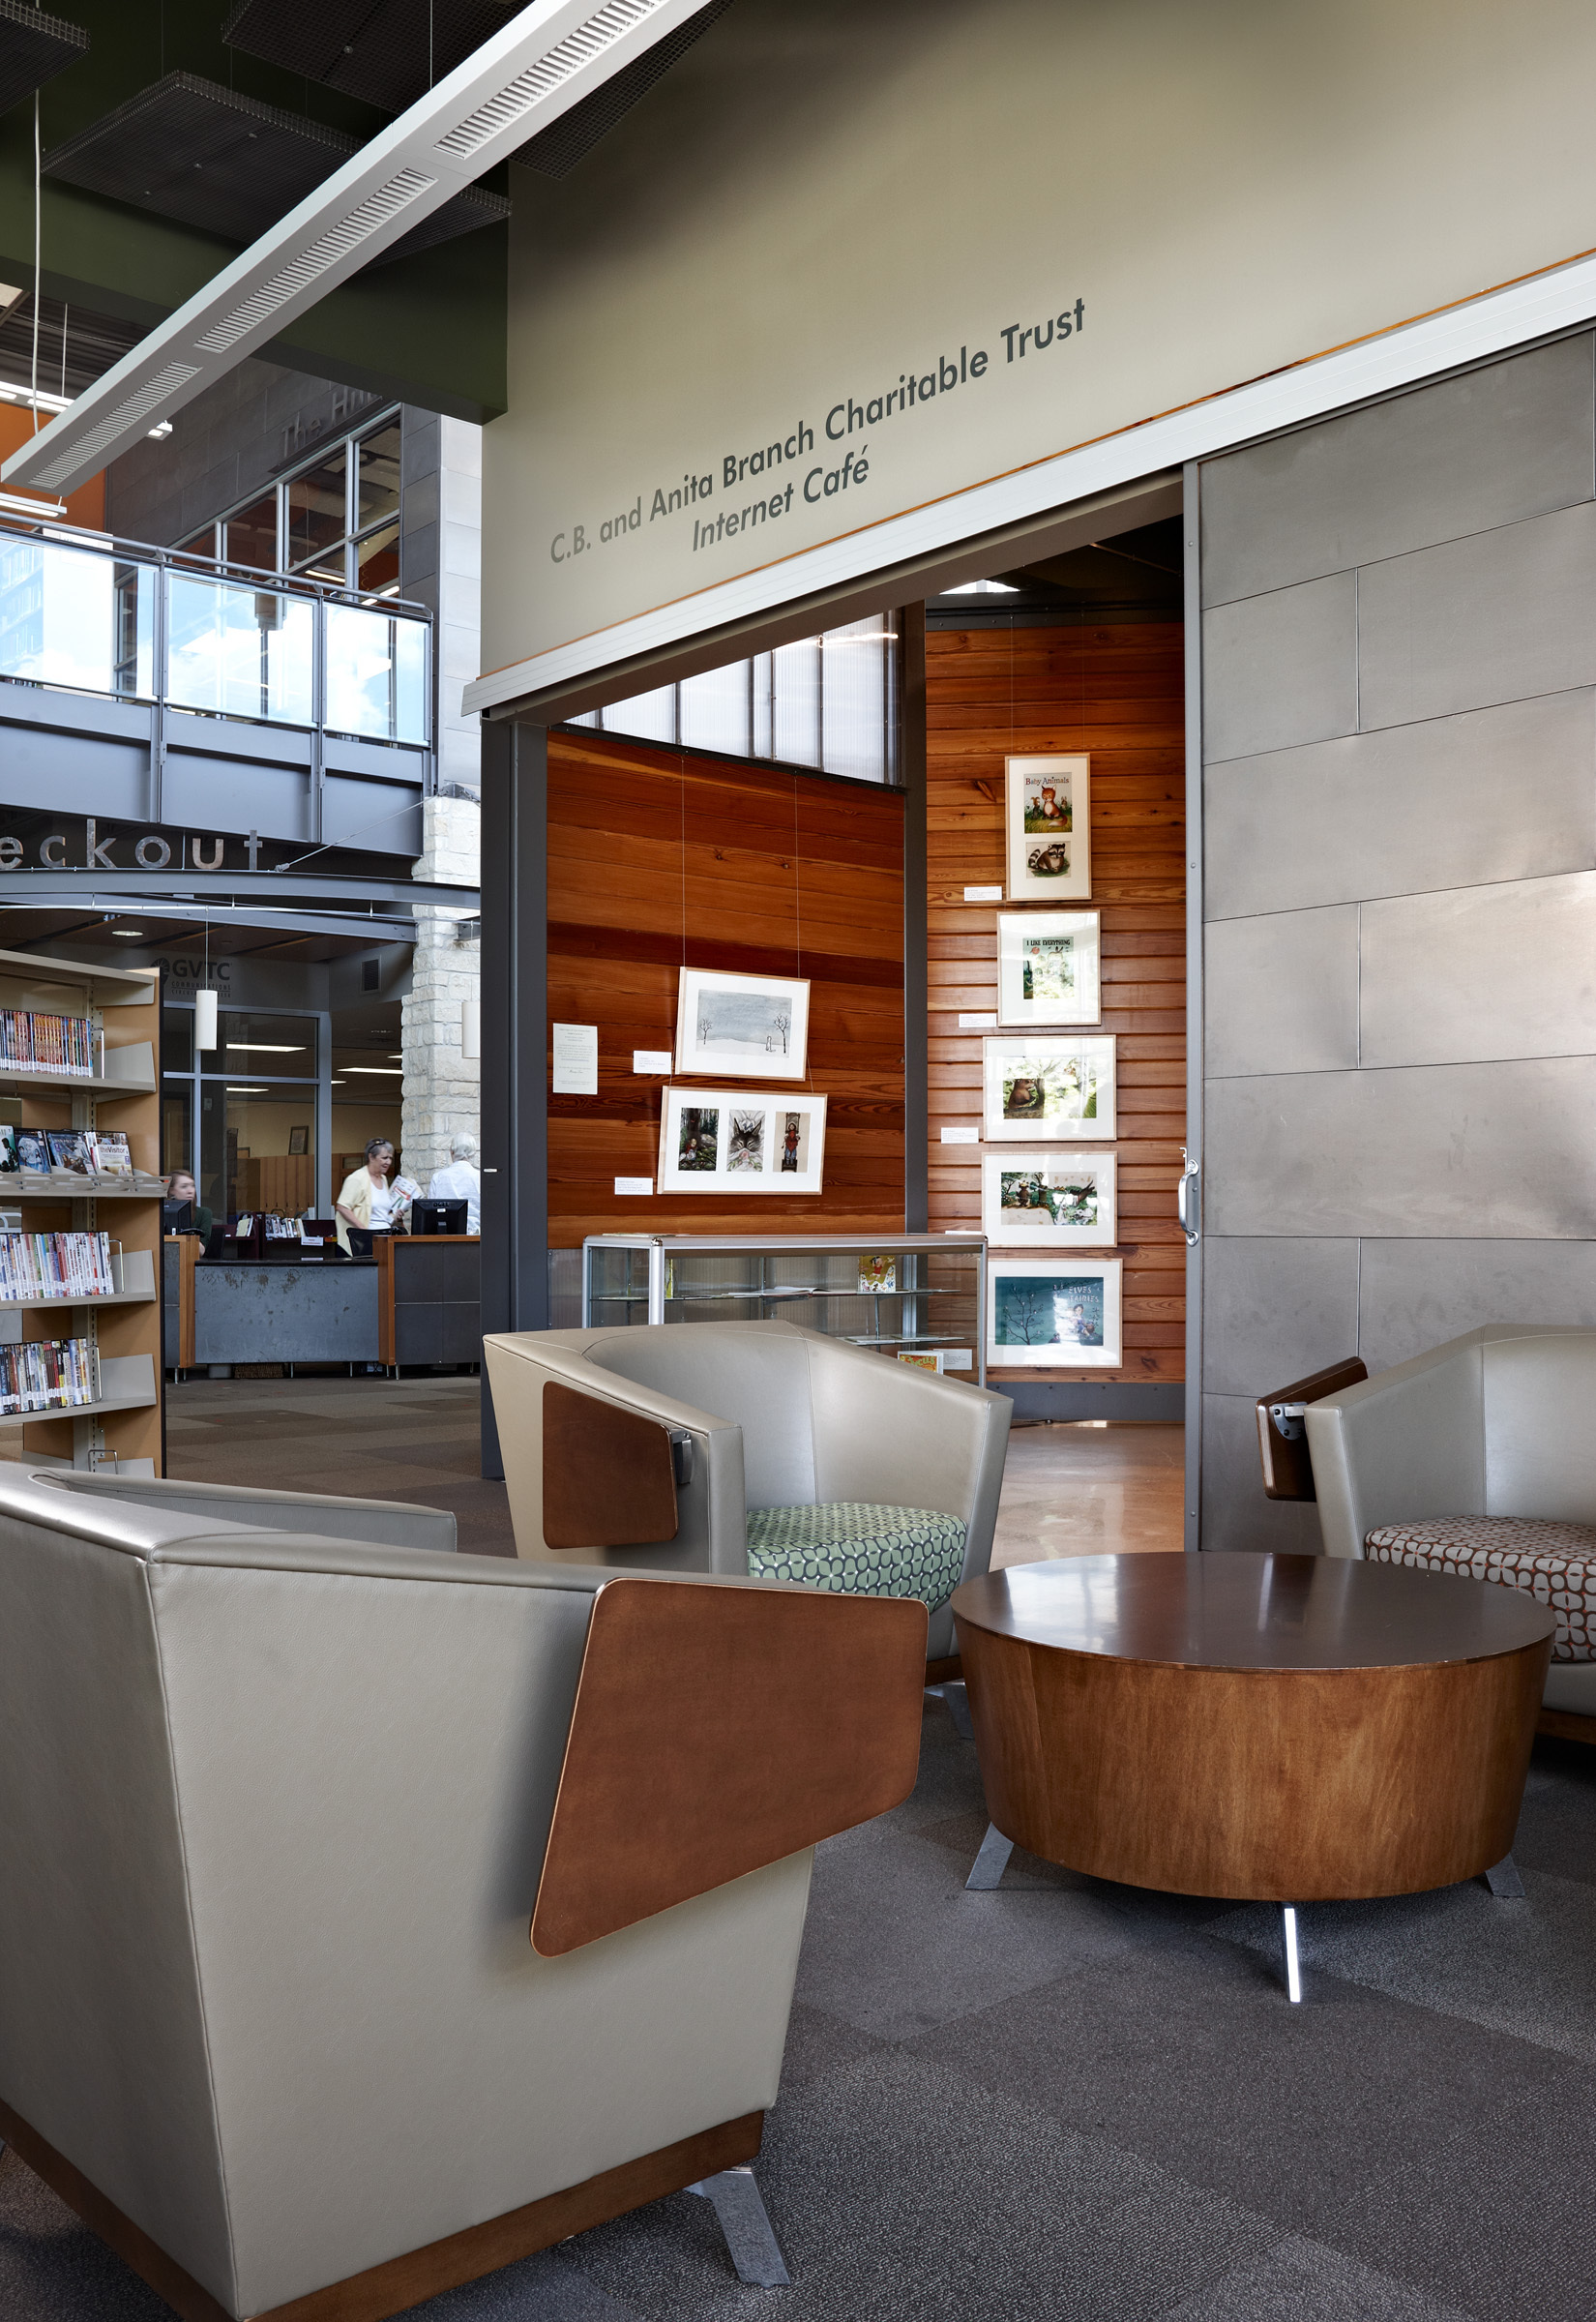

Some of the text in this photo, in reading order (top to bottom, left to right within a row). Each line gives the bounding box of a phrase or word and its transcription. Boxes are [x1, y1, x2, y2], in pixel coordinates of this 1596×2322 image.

[550, 297, 1085, 564] C.B. and Anita Branch Charitable Trust
[693, 444, 870, 551] Internet Café
[1025, 776, 1070, 786] Baby Animals
[172, 959, 231, 981] GVTC
[1068, 1286, 1092, 1295] ELVES
[1070, 1295, 1100, 1303] FAIRIES
